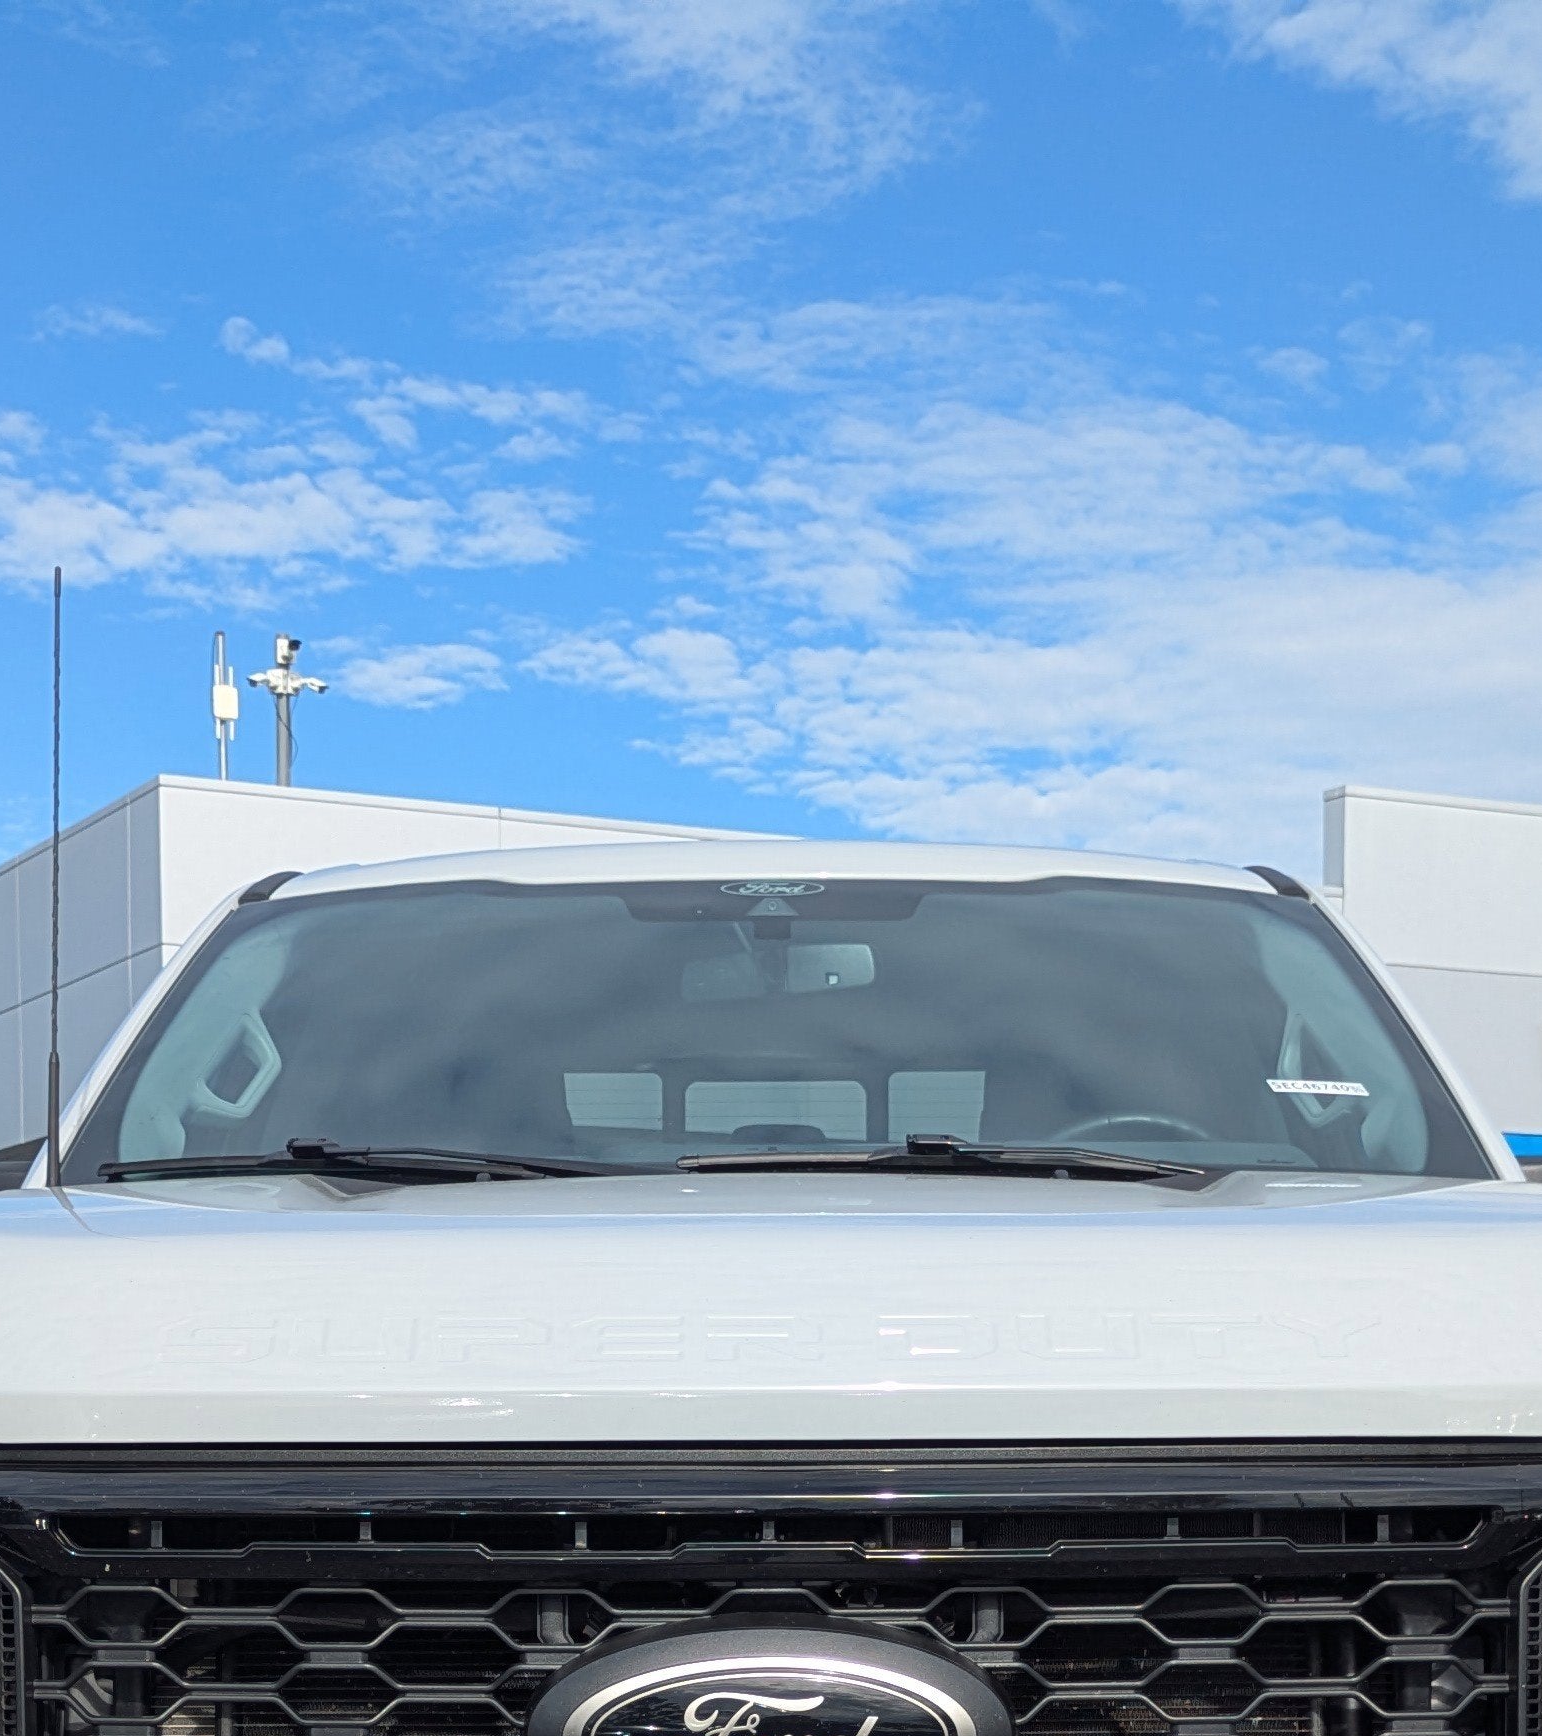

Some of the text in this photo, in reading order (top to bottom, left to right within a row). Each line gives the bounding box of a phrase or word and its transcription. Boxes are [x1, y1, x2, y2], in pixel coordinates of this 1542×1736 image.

[739, 882, 807, 894] Ford
[158, 1313, 1382, 1364] SUPER DUTY
